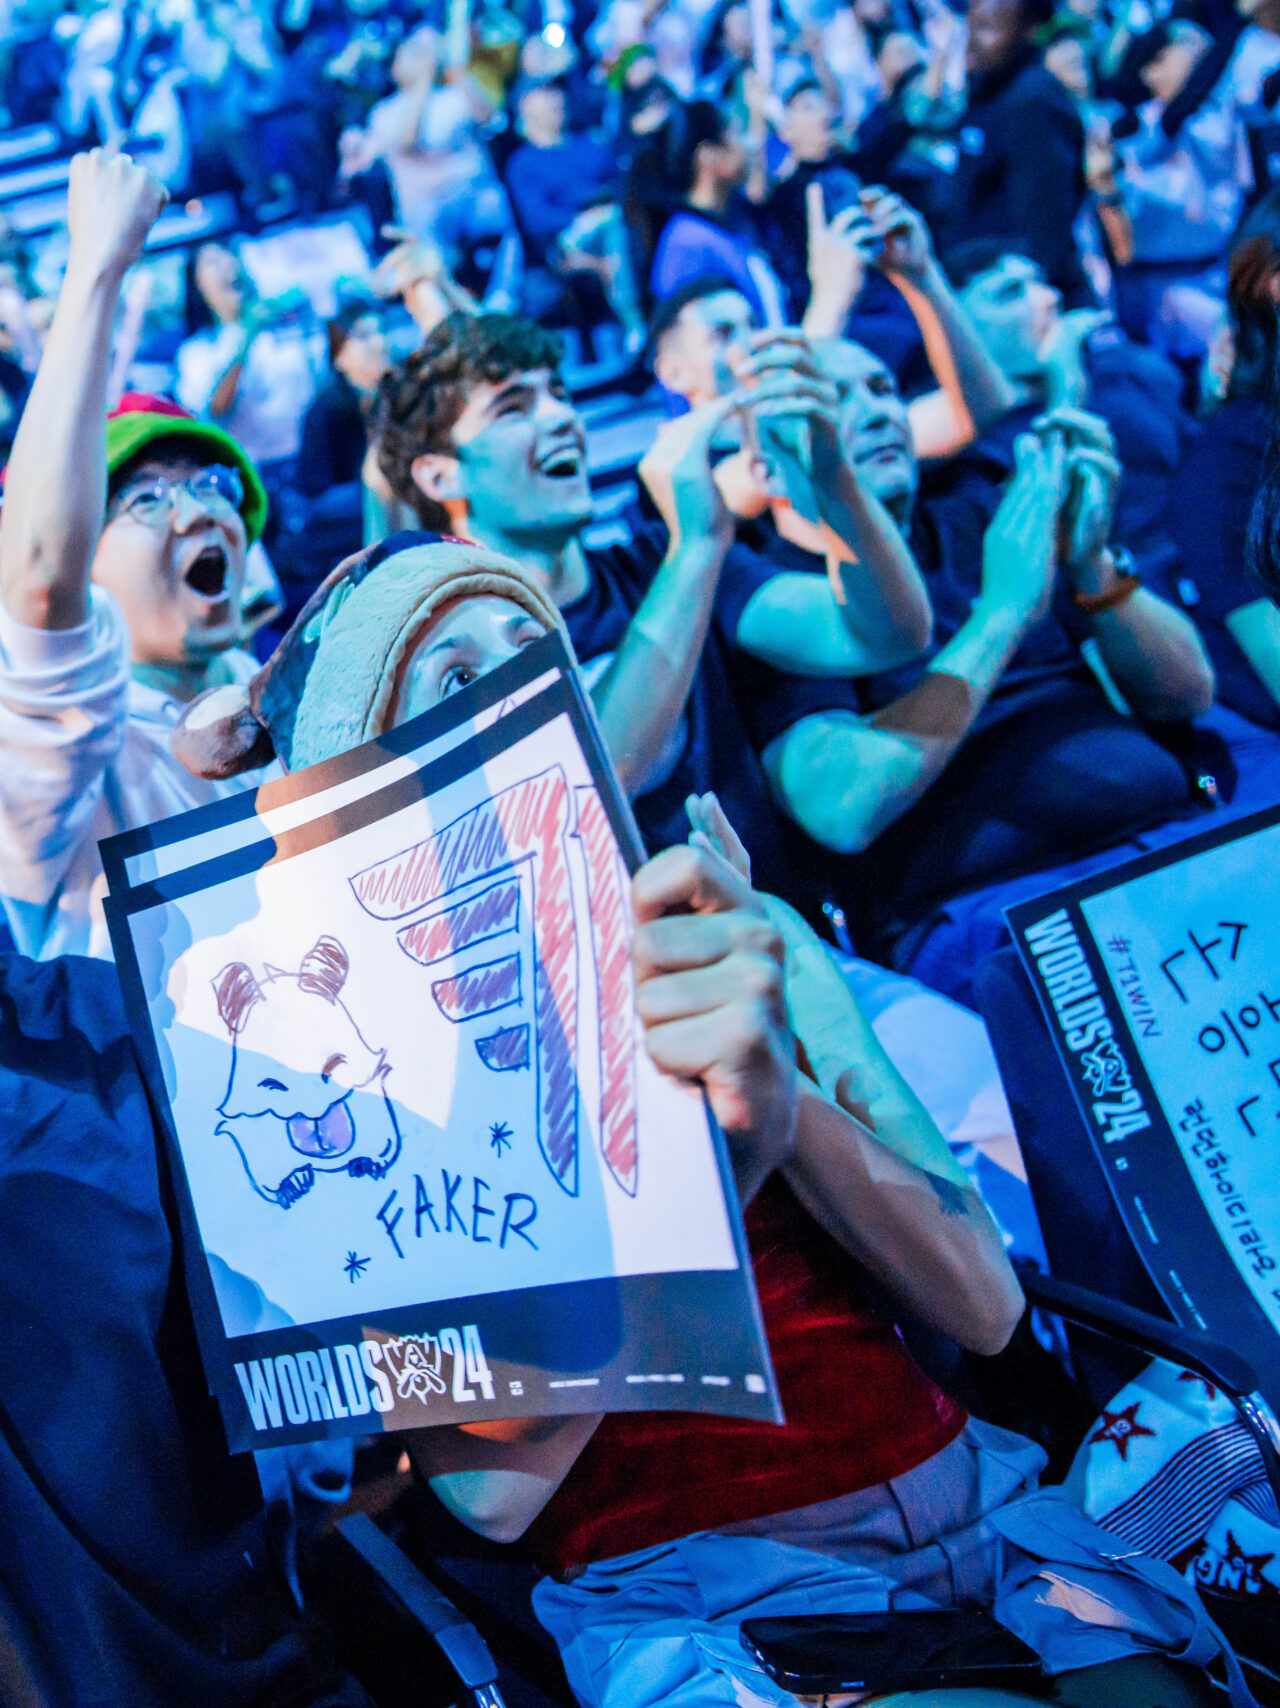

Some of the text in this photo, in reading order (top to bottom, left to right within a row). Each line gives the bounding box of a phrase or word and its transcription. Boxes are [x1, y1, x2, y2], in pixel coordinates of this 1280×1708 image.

[1024, 907, 1152, 1144] WORLDS 24
[376, 1168, 539, 1259] FAKER
[233, 1324, 496, 1431] WORLDS 24
